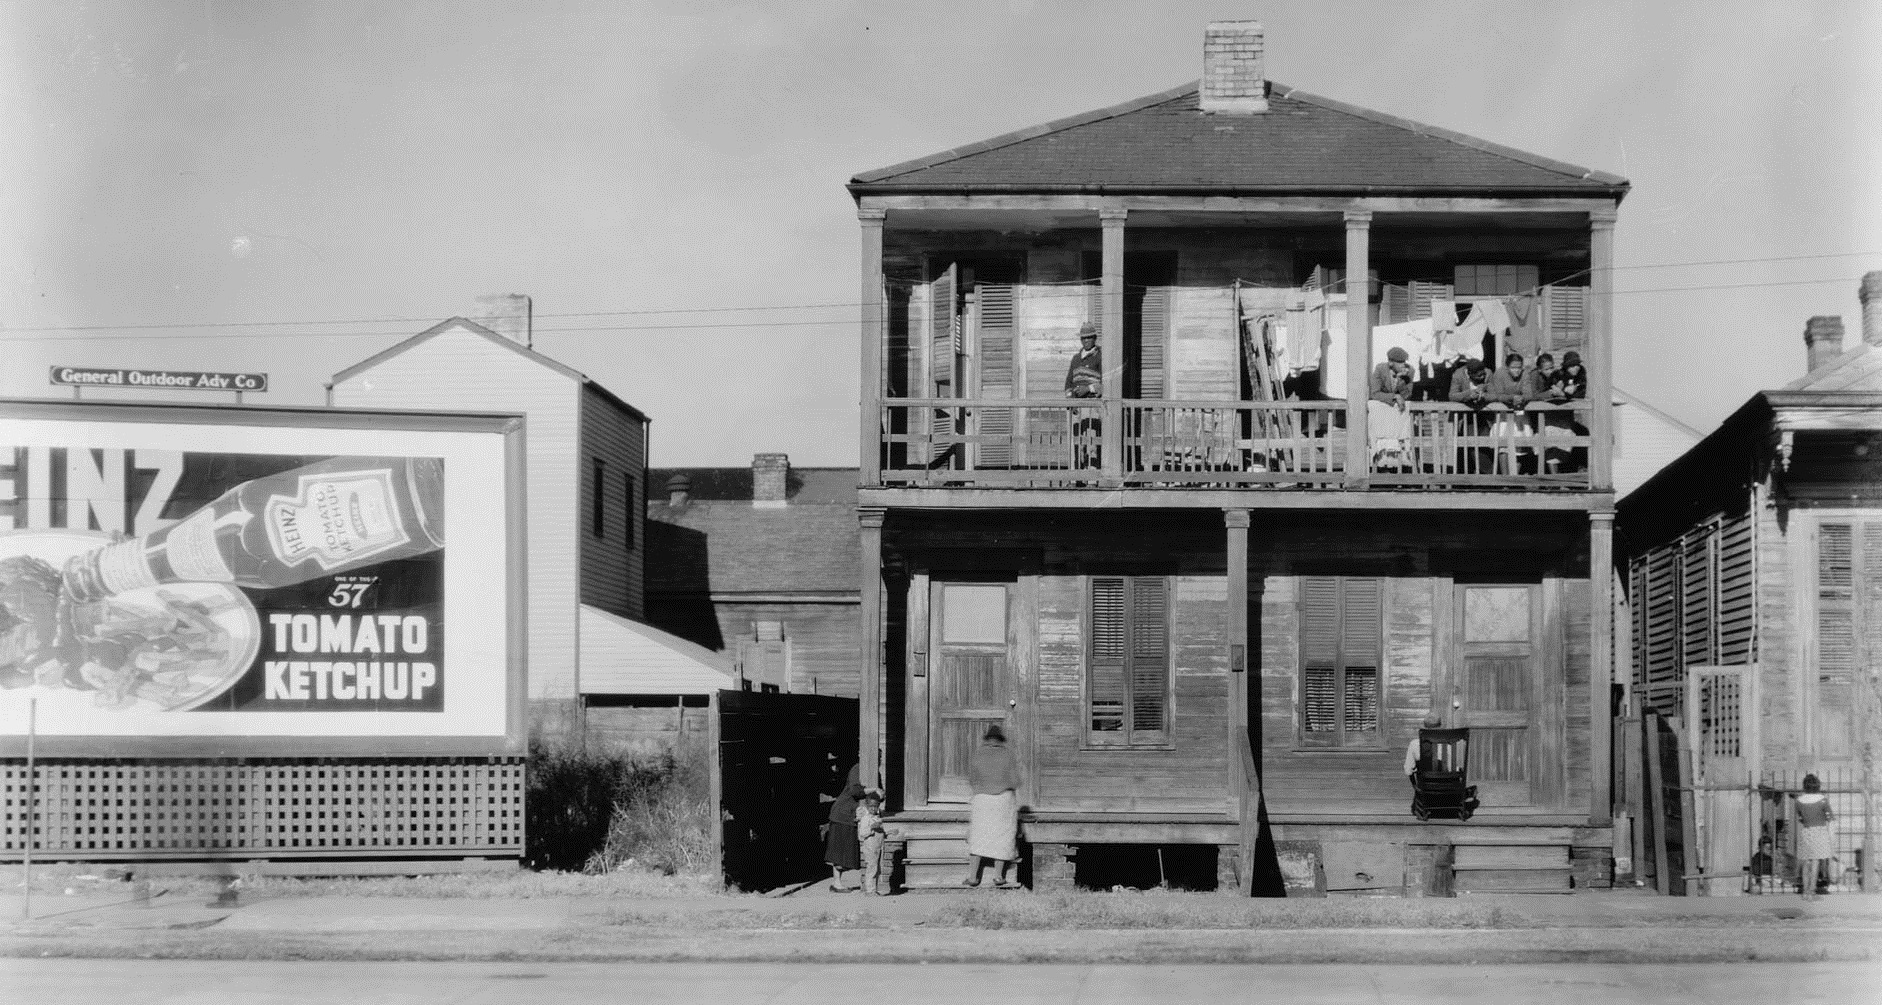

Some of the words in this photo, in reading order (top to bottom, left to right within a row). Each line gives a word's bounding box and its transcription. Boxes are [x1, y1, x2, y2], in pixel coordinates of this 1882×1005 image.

[61, 369, 123, 384] General
[128, 371, 193, 386] Outdoor
[235, 375, 256, 388] Co
[281, 508, 305, 554] HEINZ
[316, 490, 339, 551] TOMATO
[327, 484, 354, 552] KETCHUP
[328, 580, 374, 609] 57
[270, 614, 428, 654] TOMATO
[265, 661, 437, 701] KETCHUP
